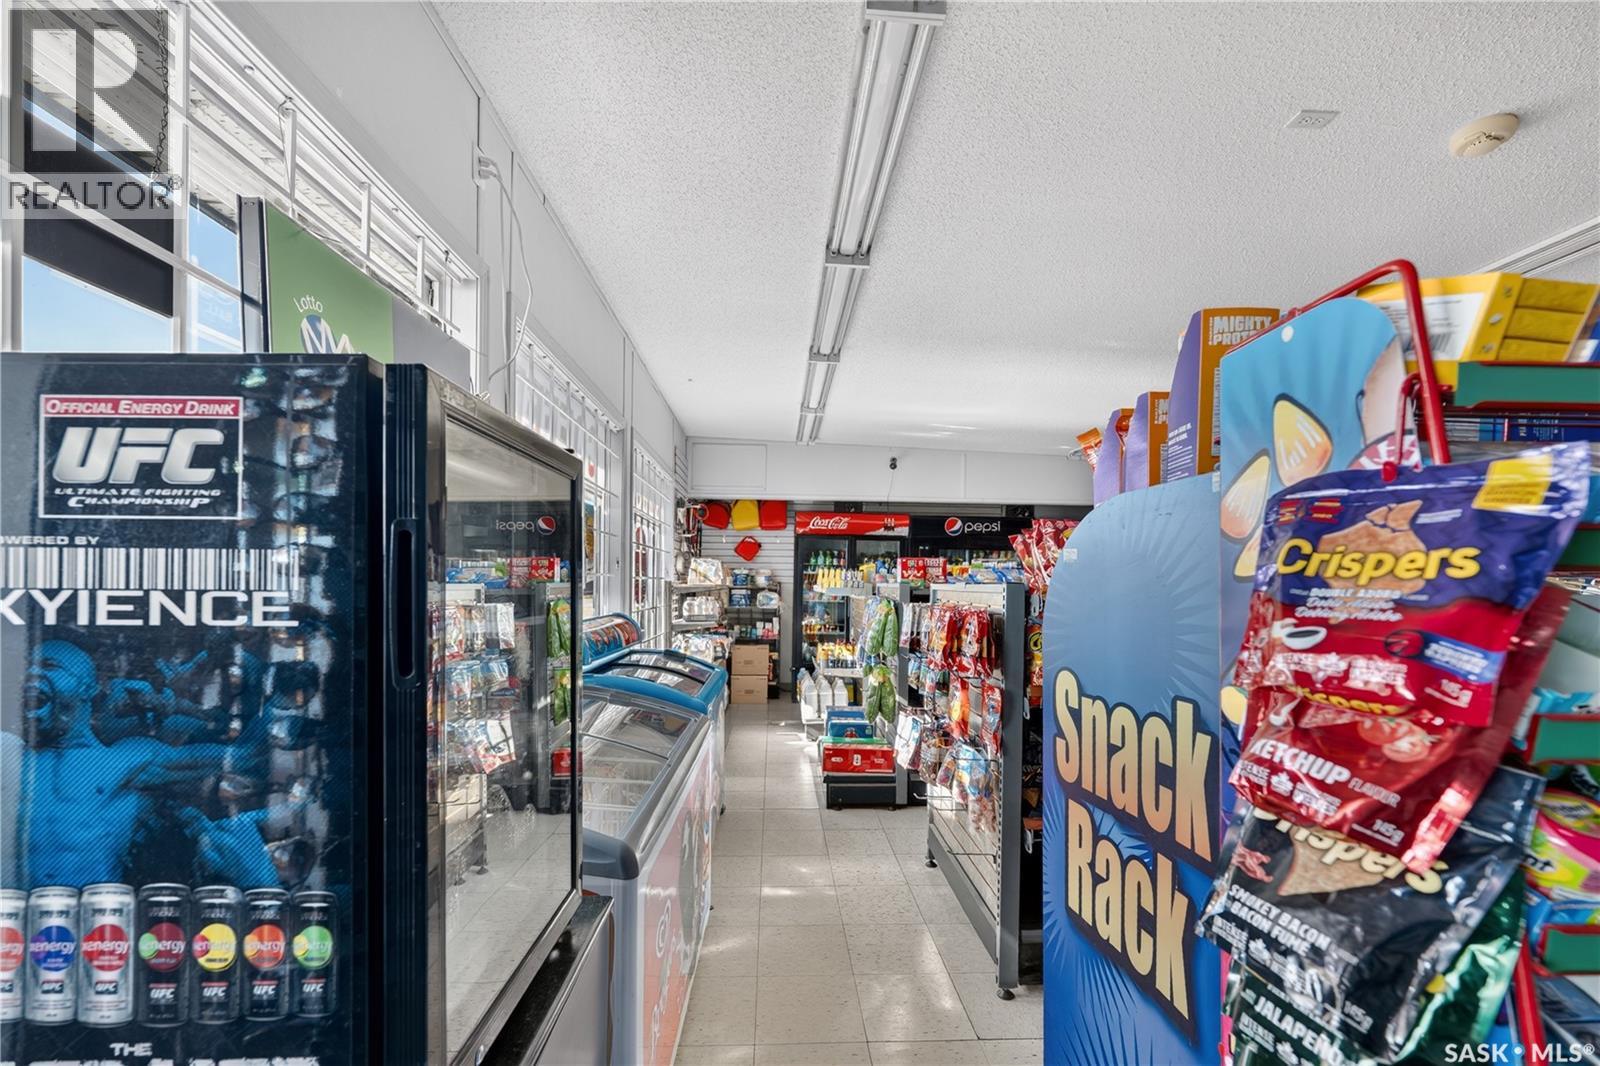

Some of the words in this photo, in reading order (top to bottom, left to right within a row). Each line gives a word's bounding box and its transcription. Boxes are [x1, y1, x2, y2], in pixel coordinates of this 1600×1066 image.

[293, 295, 324, 314] Lotto
[1213, 315, 1273, 333] MIGHTY
[46, 399, 115, 415] OFFICIAL
[117, 399, 183, 415] ENERGY
[184, 400, 236, 416] DRINK
[51, 426, 225, 485] UFC
[54, 487, 142, 497] ULTIMATE
[144, 487, 222, 497] FIGHTING
[67, 495, 211, 509] CHAMPIONSHIP
[963, 520, 1002, 534] pepsi
[0, 535, 70, 546] WERED
[74, 535, 100, 546] BY
[1275, 537, 1482, 586] Crispers
[1054, 669, 1213, 863] Snack
[1249, 738, 1352, 786] KETCHUP
[1066, 798, 1191, 1021] Rack
[1228, 883, 1282, 919] SMOKEY
[1277, 911, 1332, 952] BACON
[1230, 899, 1273, 939] BACON
[150, 987, 176, 999] UFC
[202, 986, 227, 997] UFC
[253, 983, 277, 995] UFC
[302, 982, 325, 993] UFC
[110, 1042, 154, 1058] THE
